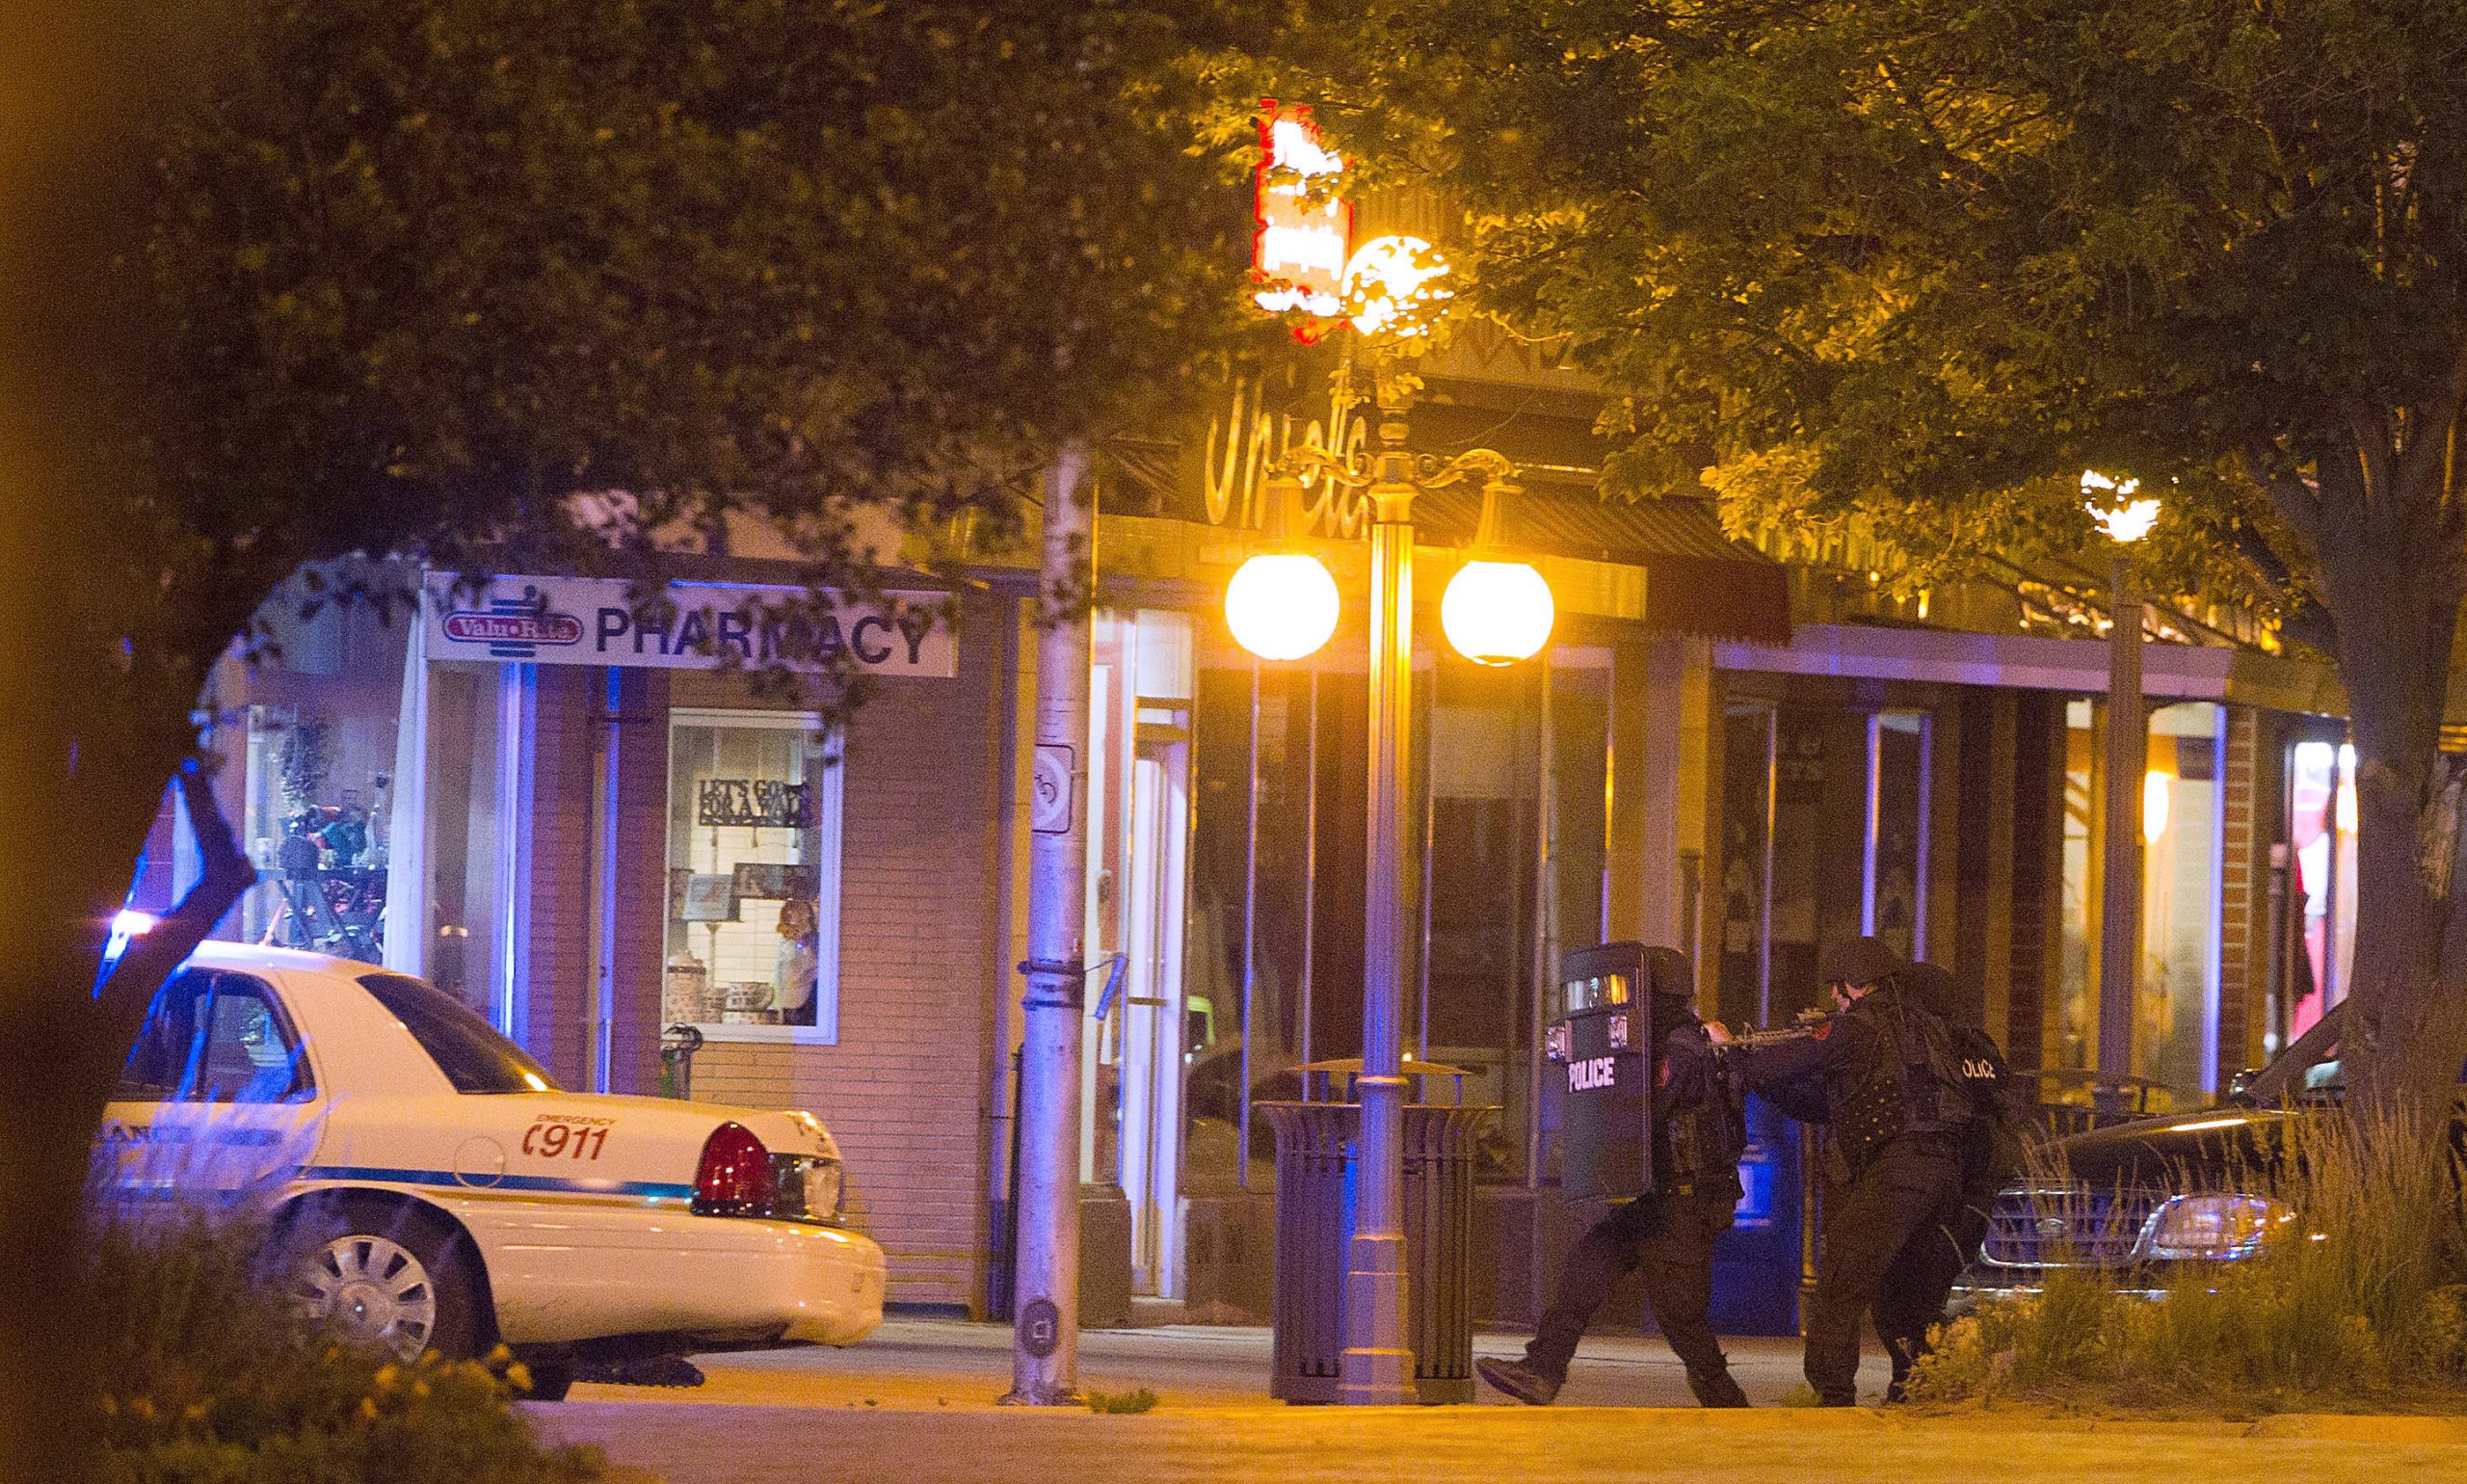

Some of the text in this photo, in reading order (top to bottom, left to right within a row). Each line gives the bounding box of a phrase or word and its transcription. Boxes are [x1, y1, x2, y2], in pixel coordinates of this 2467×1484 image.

[1568, 1056, 1615, 1093] POLICE
[536, 1114, 616, 1126] EMERGENCY
[539, 1125, 609, 1160] 911
